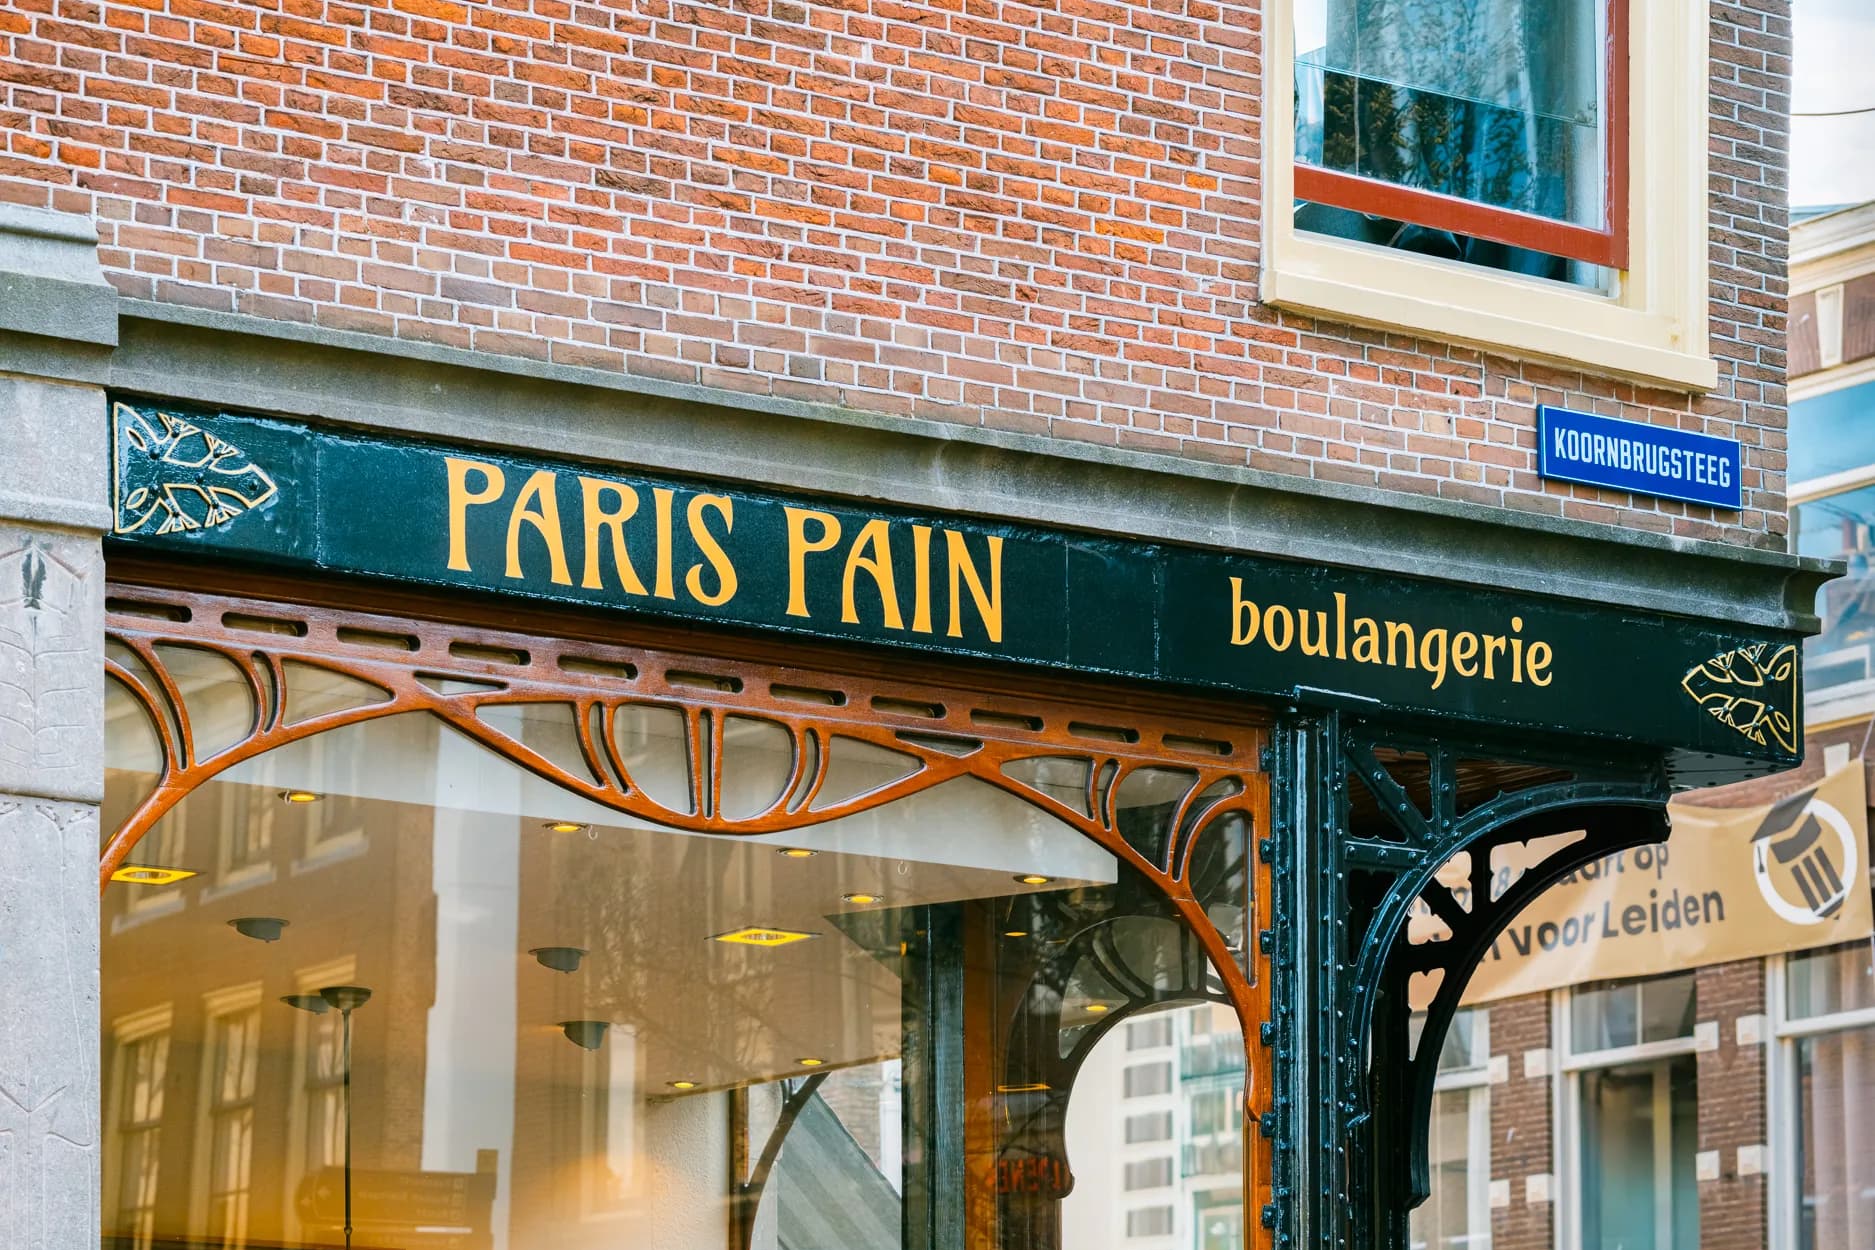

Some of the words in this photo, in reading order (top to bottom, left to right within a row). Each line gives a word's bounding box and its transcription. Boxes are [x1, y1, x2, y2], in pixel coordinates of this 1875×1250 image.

[1554, 427, 1731, 488] KOORNBRUGSTEEG
[445, 456, 738, 606] PARIS
[784, 506, 1003, 643] PAIN
[1229, 577, 1553, 690] boulangerie
[1634, 843, 1669, 880] op
[1508, 911, 1595, 957] voor
[1602, 888, 1725, 939] Leiden
